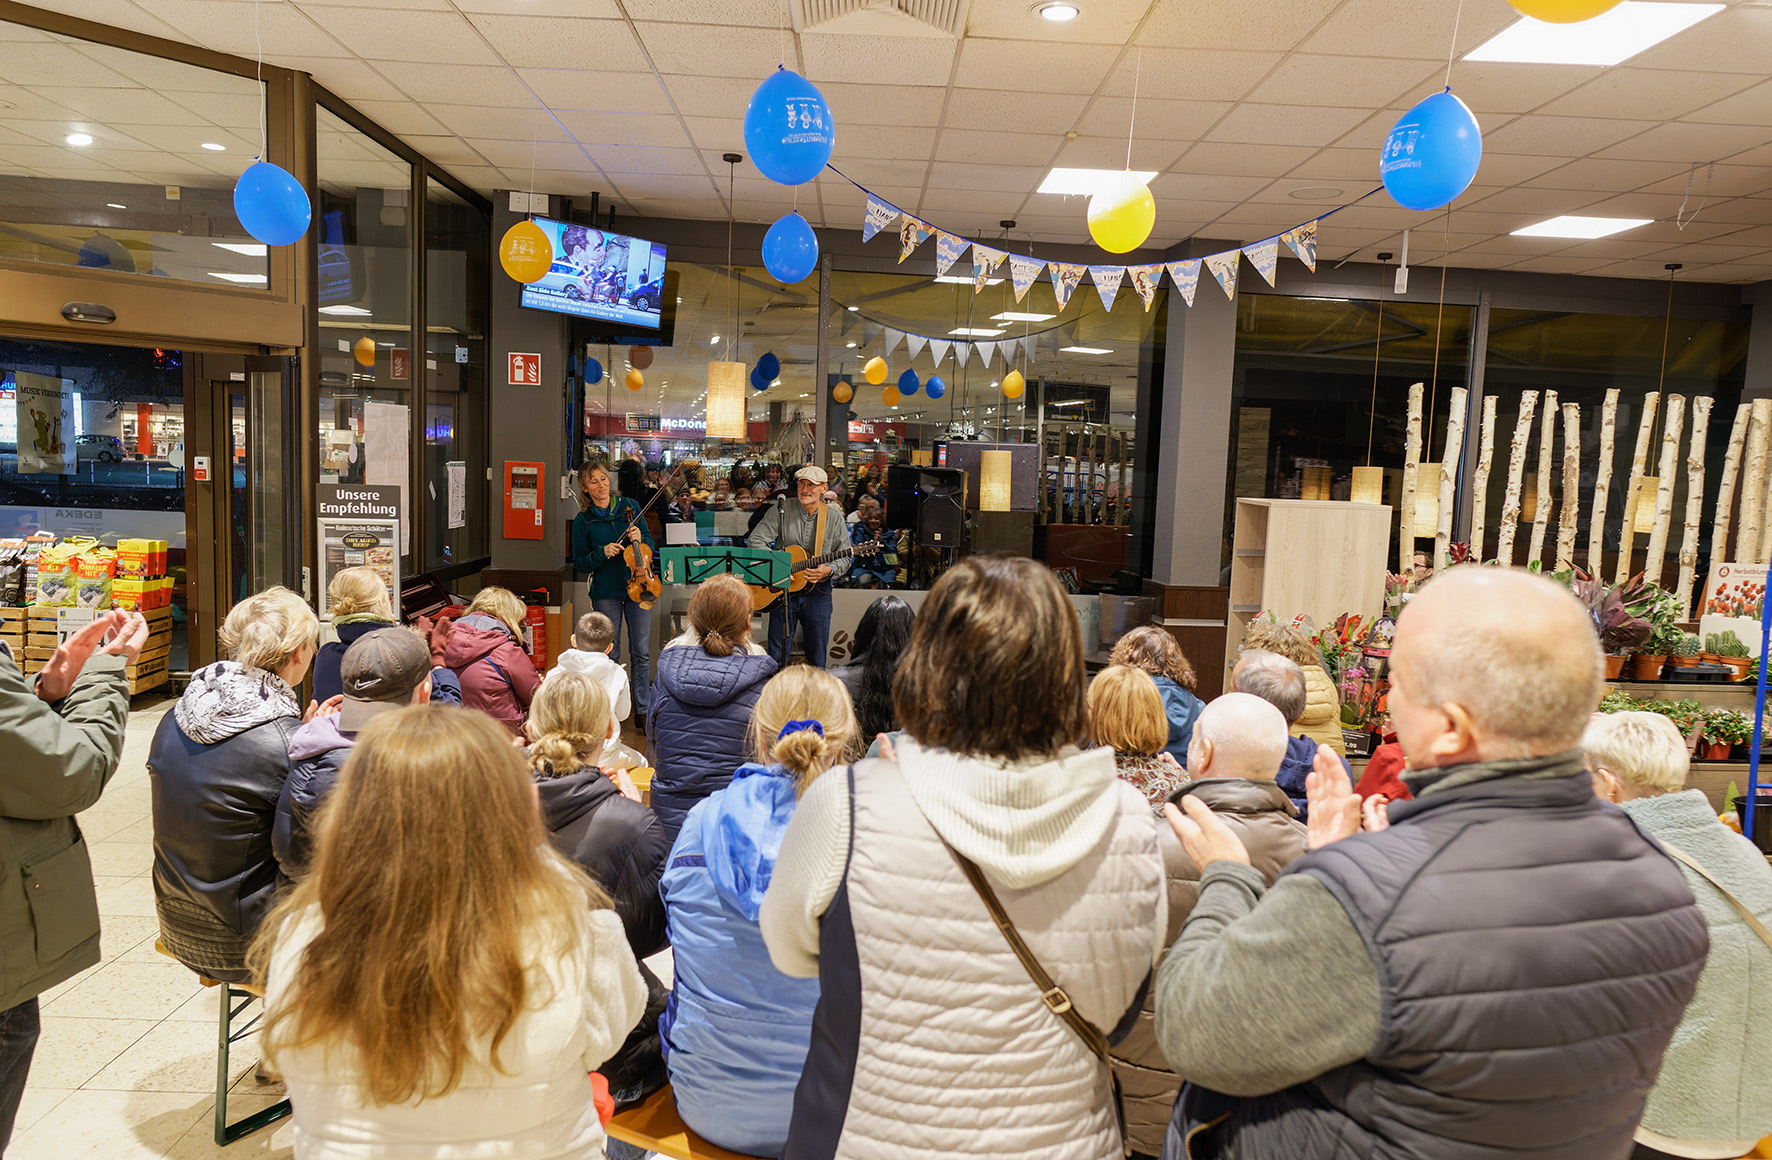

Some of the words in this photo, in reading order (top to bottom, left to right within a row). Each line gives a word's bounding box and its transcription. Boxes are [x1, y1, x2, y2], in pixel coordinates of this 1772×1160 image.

[550, 289, 568, 298] Gallery
[20, 386, 41, 395] MUSIK
[336, 489, 380, 501] Unsere
[319, 502, 397, 517] Empfehlung
